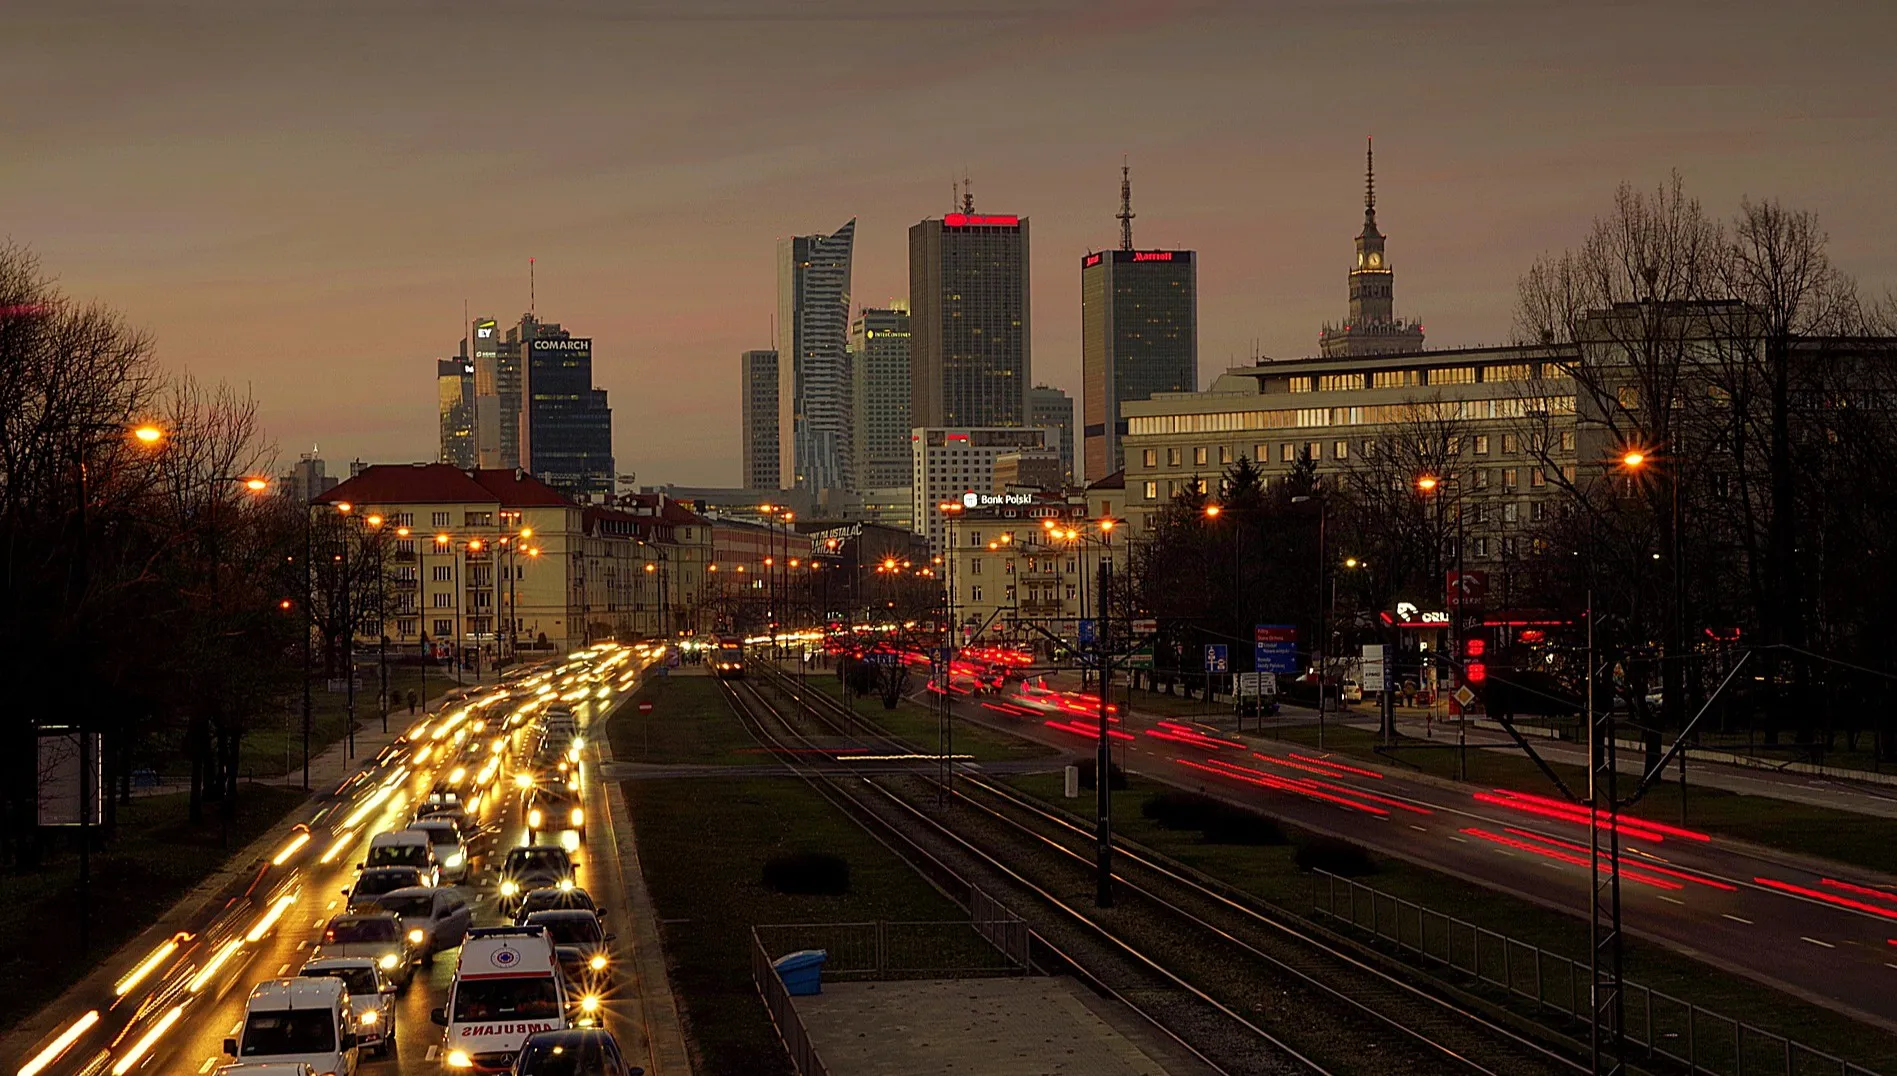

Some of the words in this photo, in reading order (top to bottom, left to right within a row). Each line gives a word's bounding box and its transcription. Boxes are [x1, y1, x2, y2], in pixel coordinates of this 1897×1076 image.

[1133, 252, 1172, 262] Marriott
[477, 328, 492, 338] EY
[534, 340, 589, 350] COMARCH
[981, 494, 1003, 504] Bank
[1005, 493, 1032, 505] Polski
